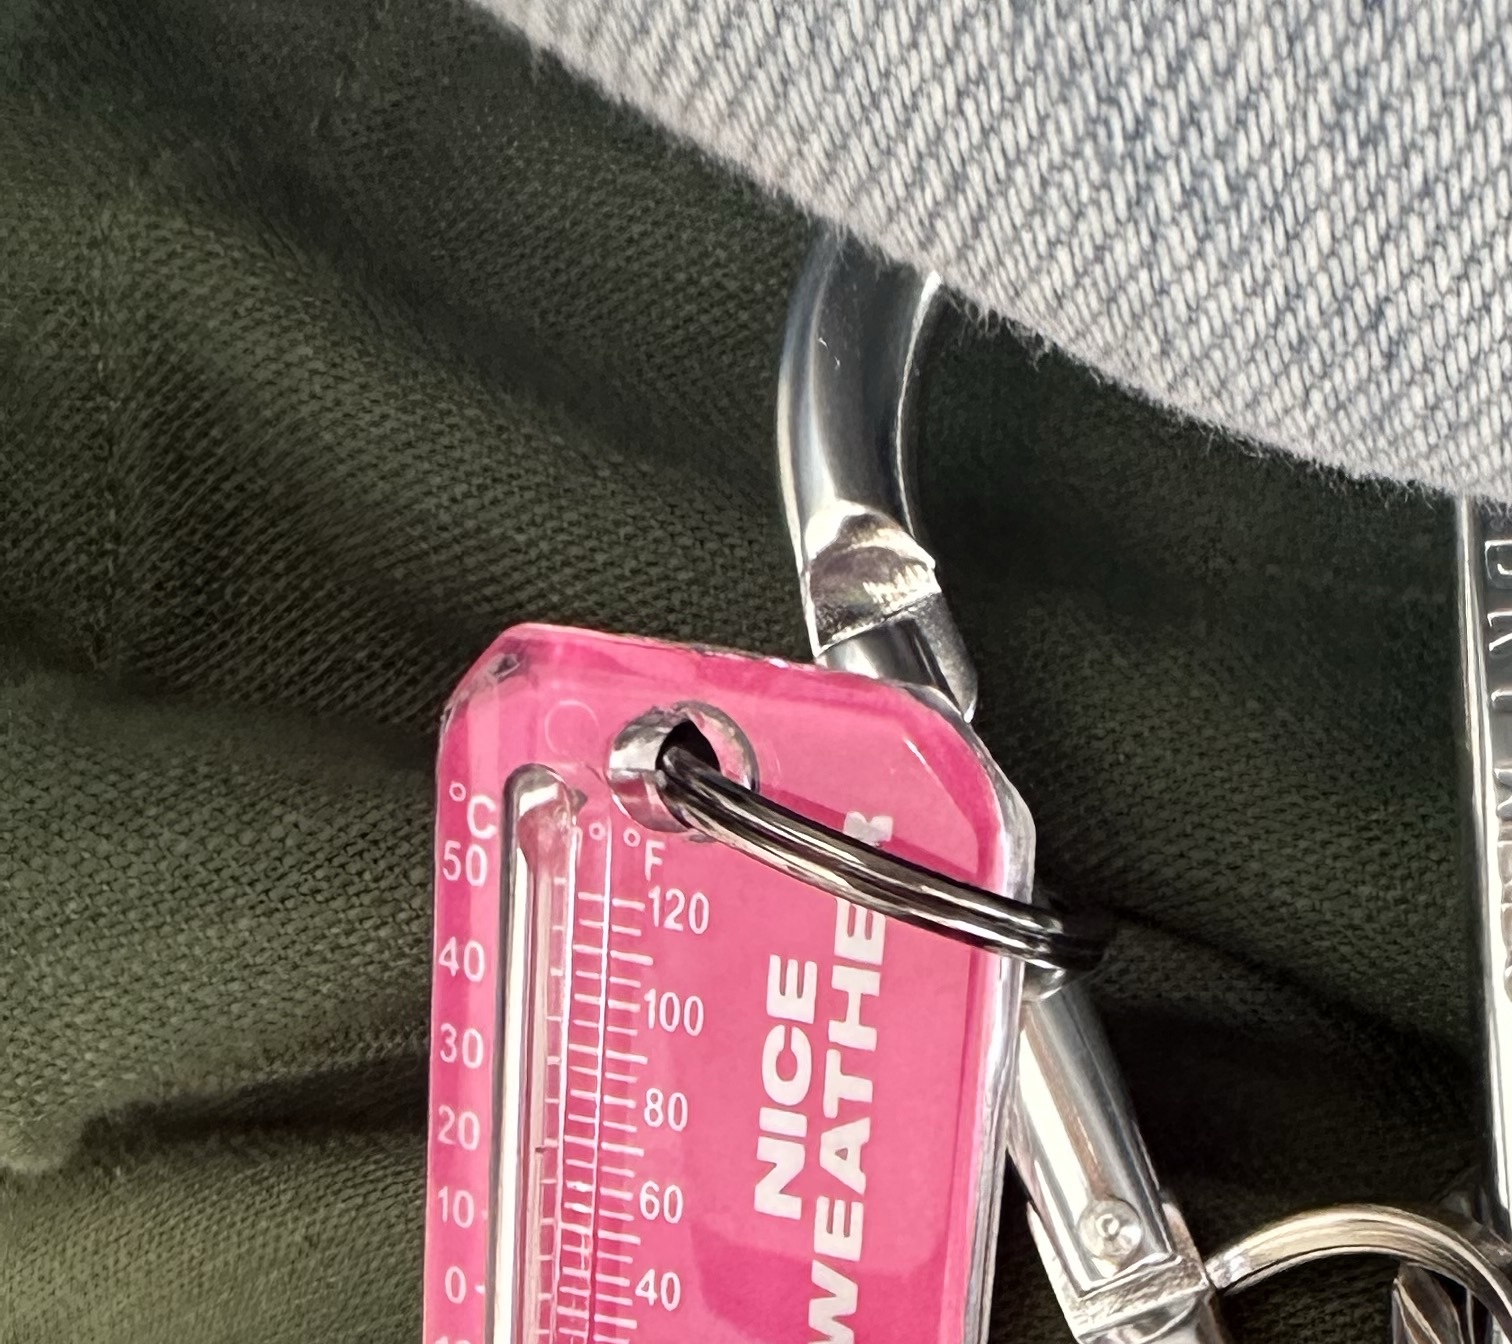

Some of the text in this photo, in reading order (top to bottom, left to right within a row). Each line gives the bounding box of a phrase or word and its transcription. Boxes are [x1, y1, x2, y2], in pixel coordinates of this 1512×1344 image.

[442, 839, 488, 888] 50
[647, 884, 711, 936] 120
[438, 936, 486, 983] 40
[643, 987, 705, 1037] 100
[439, 1022, 485, 1067] 30
[642, 1088, 689, 1132] 80
[753, 954, 818, 1221] NICE
[437, 1104, 481, 1152] 20
[437, 1185, 475, 1229] 10
[639, 1180, 685, 1224] 60
[444, 1265, 467, 1304] 0
[634, 1268, 682, 1312] 40
